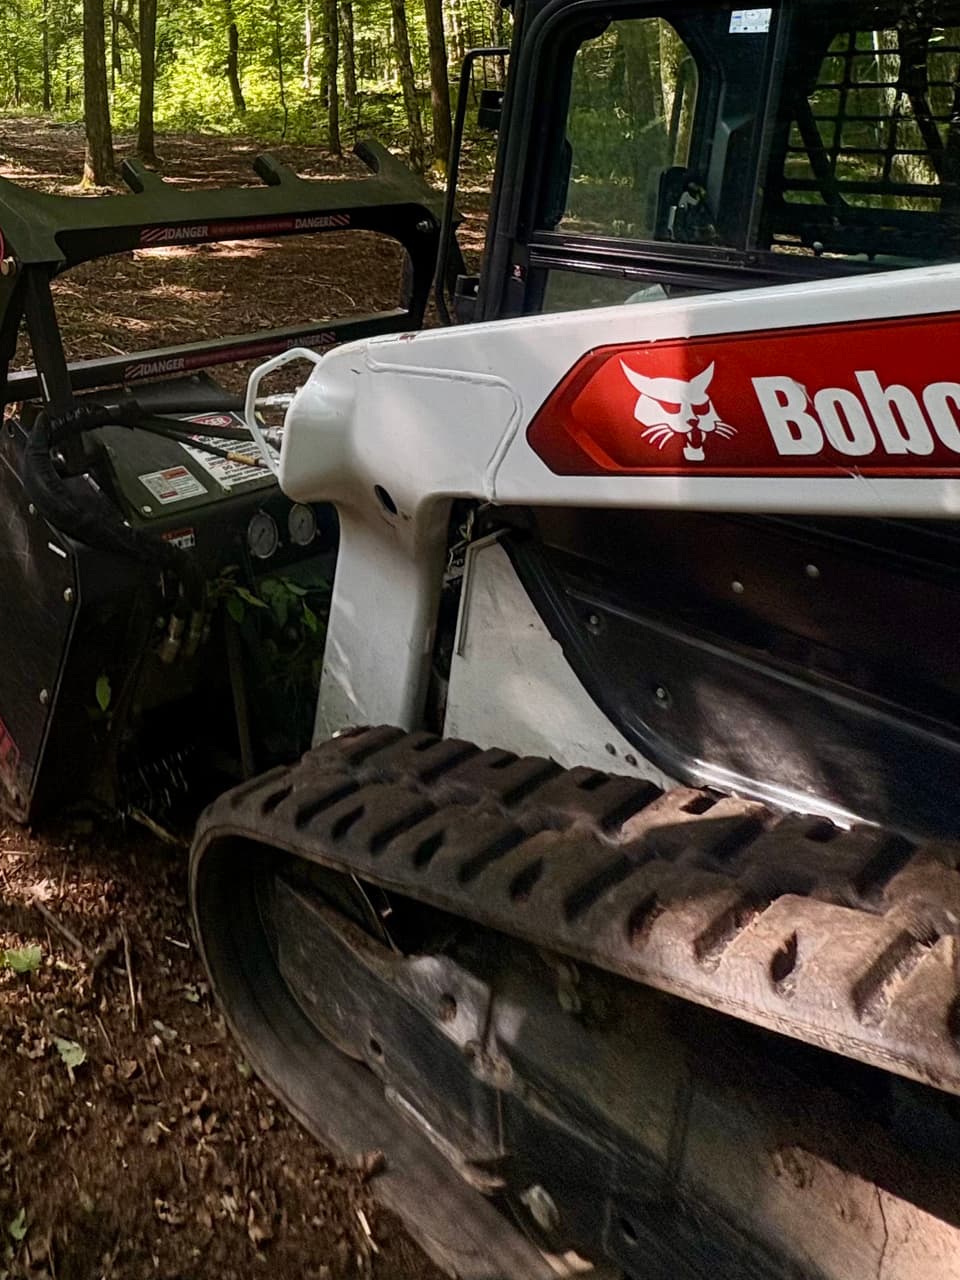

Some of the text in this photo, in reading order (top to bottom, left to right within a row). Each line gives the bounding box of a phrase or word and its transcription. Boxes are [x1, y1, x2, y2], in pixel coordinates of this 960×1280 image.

[167, 225, 209, 240] DANGER
[143, 358, 185, 376] DANGER
[751, 370, 960, 456] Bobc
